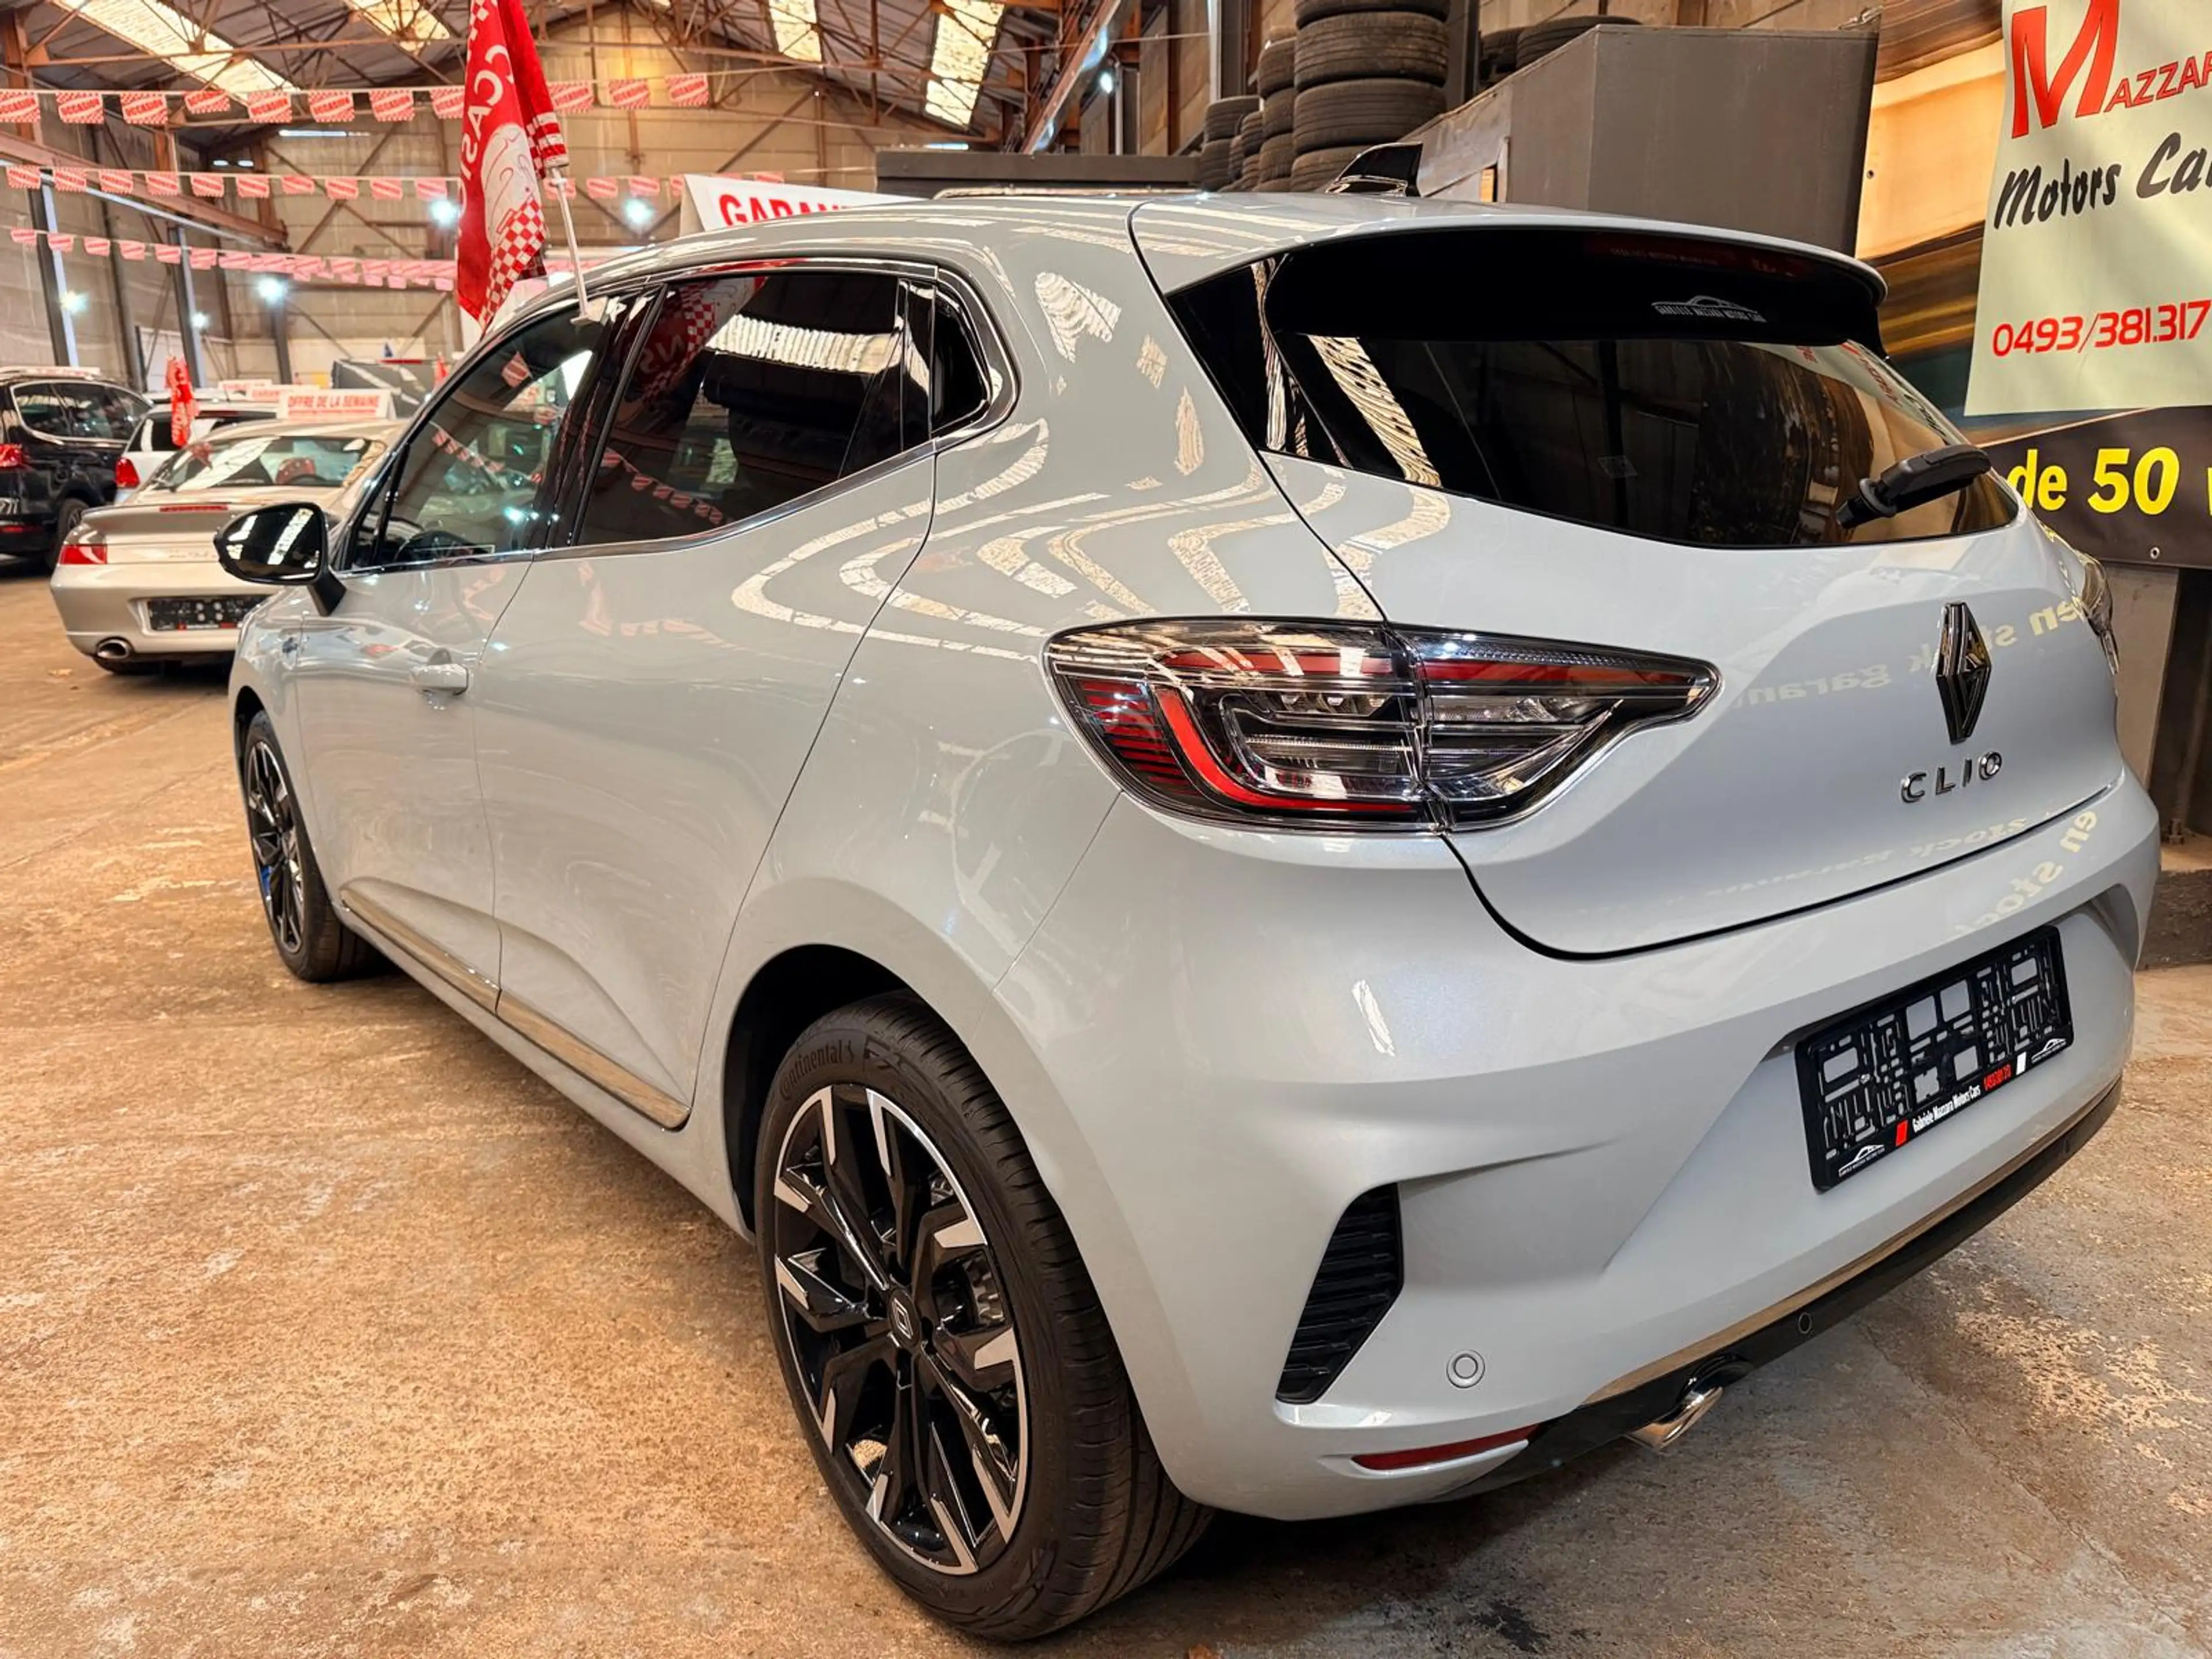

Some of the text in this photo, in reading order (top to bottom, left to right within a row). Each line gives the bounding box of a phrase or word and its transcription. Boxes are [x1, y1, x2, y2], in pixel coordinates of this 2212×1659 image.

[1994, 158, 2122, 230] Motors
[1993, 300, 2212, 357] 0493/381.317
[317, 396, 327, 408] DE
[330, 396, 340, 408] LA
[2006, 449, 2067, 512] de
[2087, 446, 2180, 516] 50
[1901, 752, 2002, 803] CLIO
[779, 1039, 843, 1101] Continental
